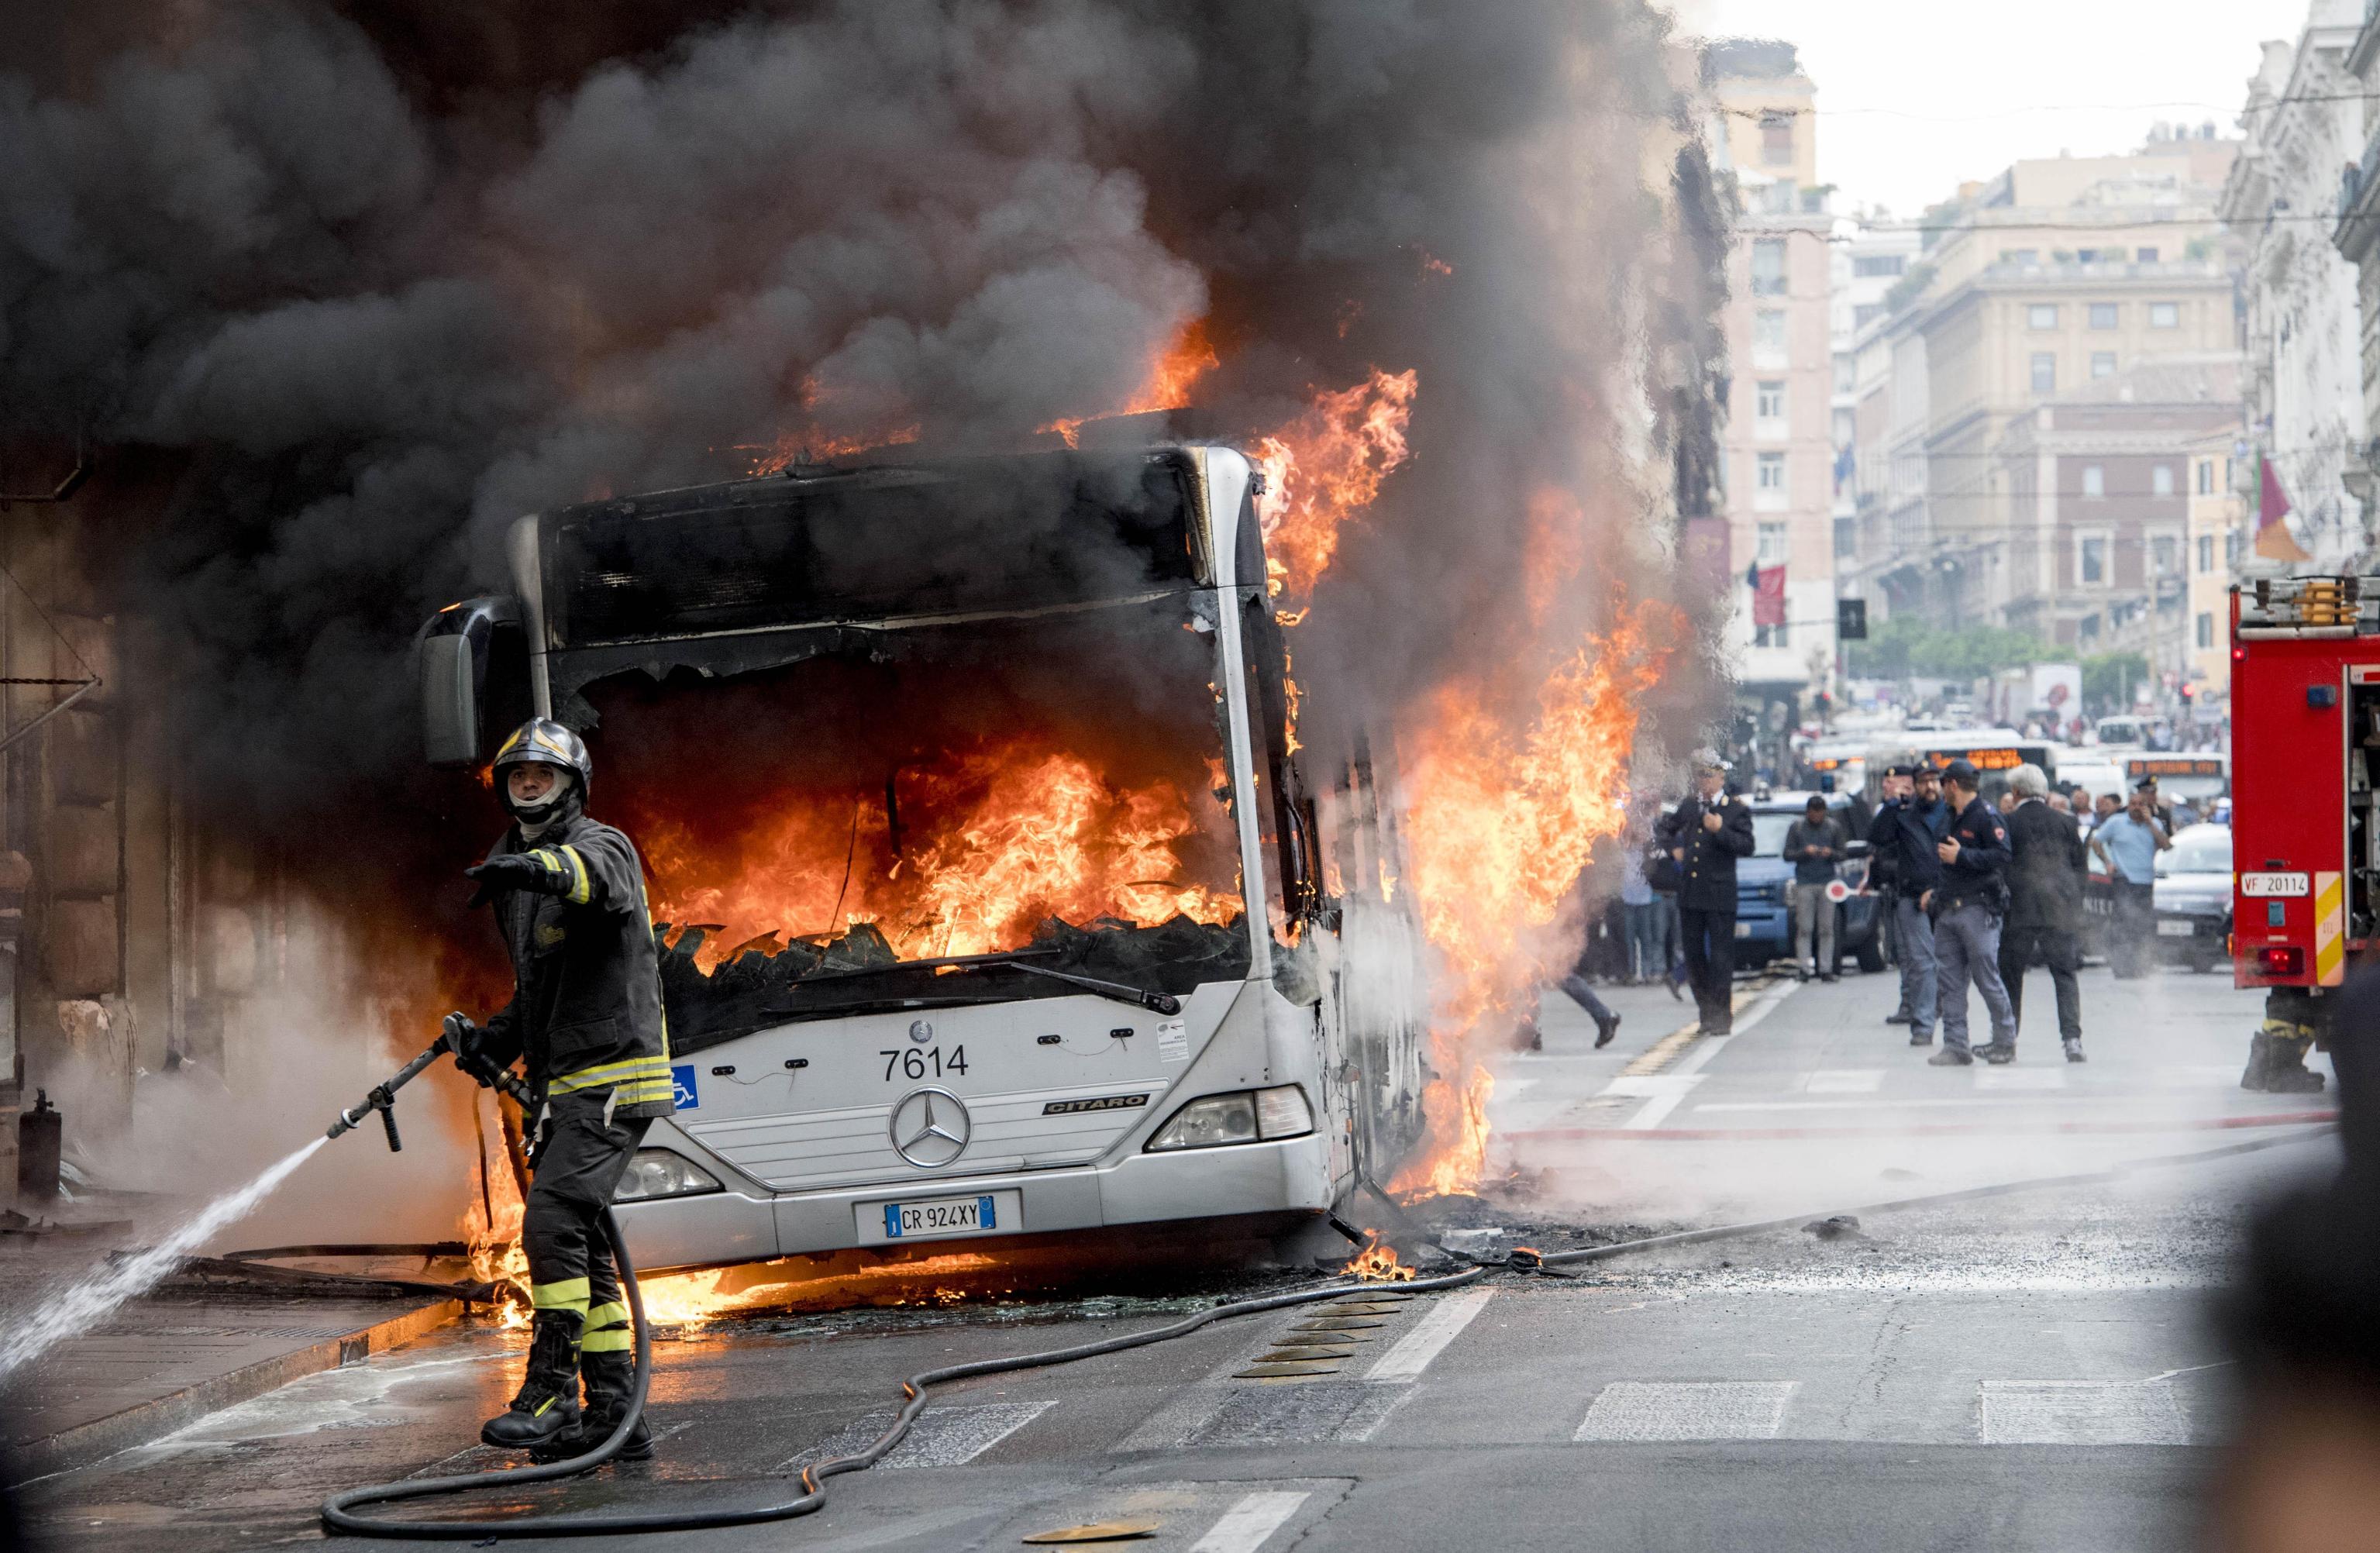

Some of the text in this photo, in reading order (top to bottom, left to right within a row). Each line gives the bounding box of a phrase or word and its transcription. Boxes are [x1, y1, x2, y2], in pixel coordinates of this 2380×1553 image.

[2245, 877, 2305, 891] VF 20114
[880, 1045, 969, 1081] 7614
[1048, 1096, 1145, 1113] CITARO
[902, 1210, 922, 1229] CR
[927, 1204, 977, 1228] 924XY
